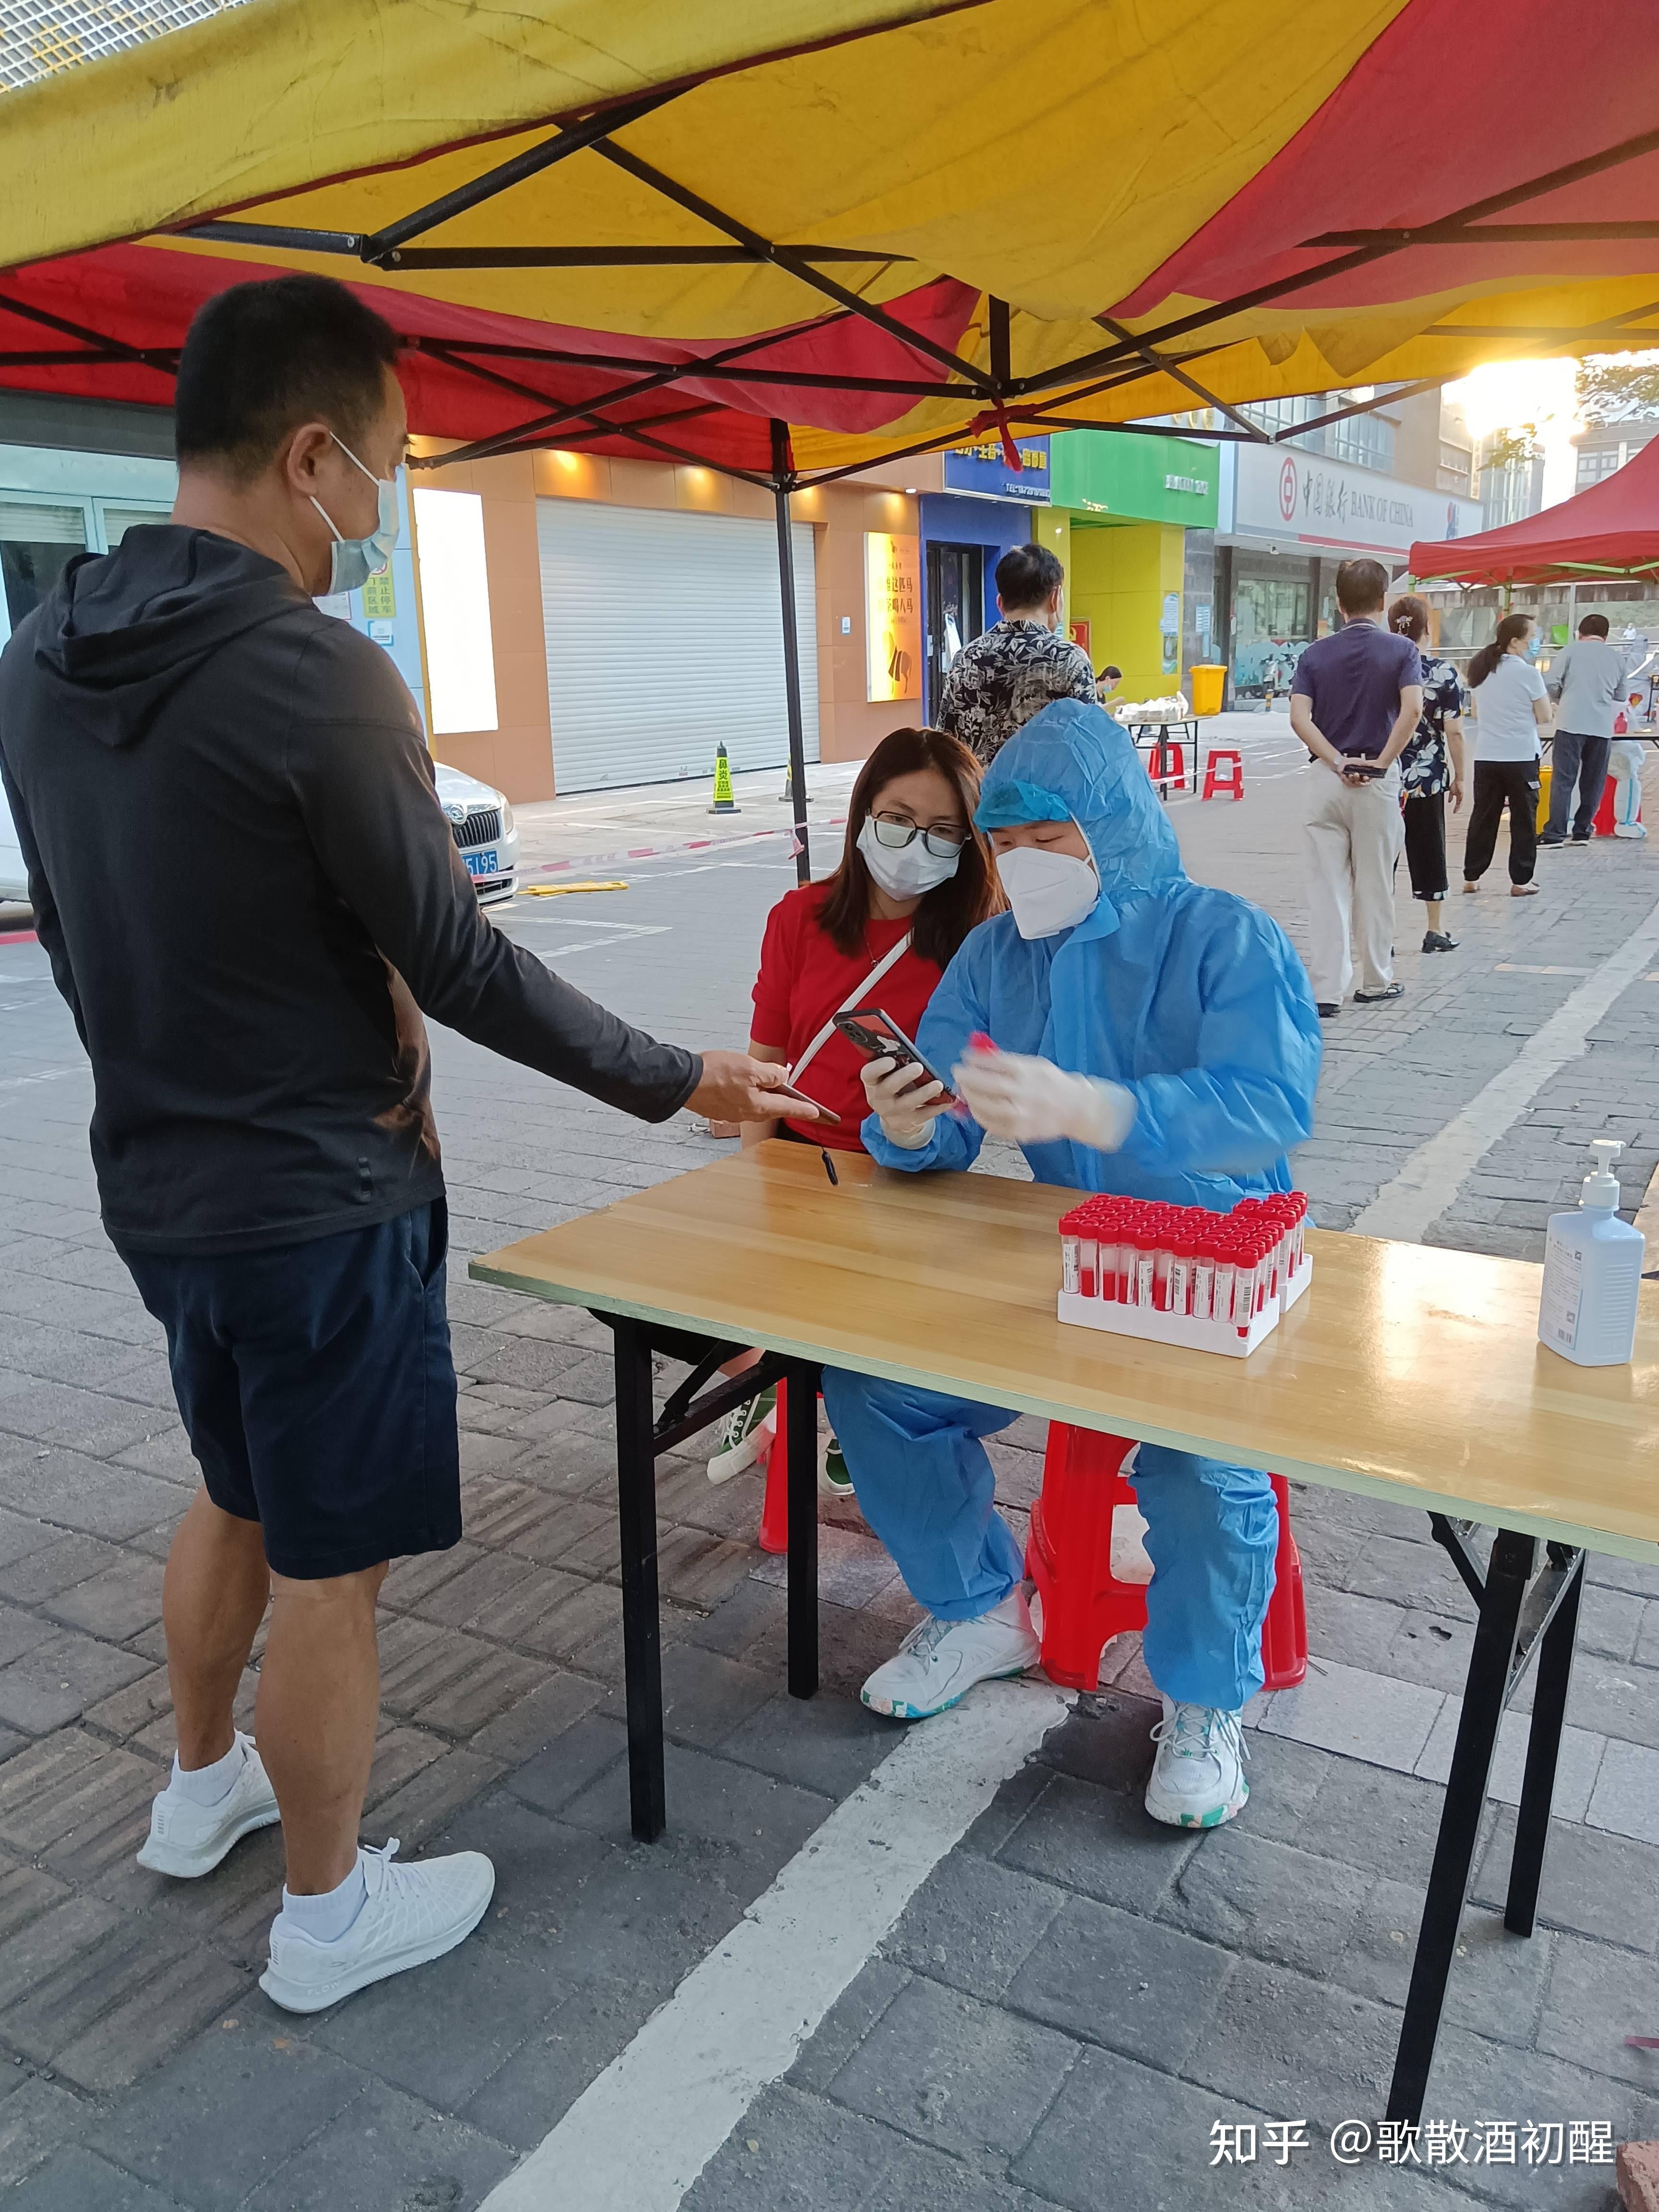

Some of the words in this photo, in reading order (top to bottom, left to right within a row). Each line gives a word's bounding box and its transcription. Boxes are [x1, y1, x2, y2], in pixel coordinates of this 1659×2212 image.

[1302, 469, 1348, 523] 中国银行
[1351, 491, 1375, 519] BANK
[1376, 498, 1388, 522] OF
[1389, 500, 1414, 528] CHINA
[379, 577, 392, 614] 禁止停车
[462, 854, 497, 876] 5195
[308, 1980, 340, 1996] FLOW
